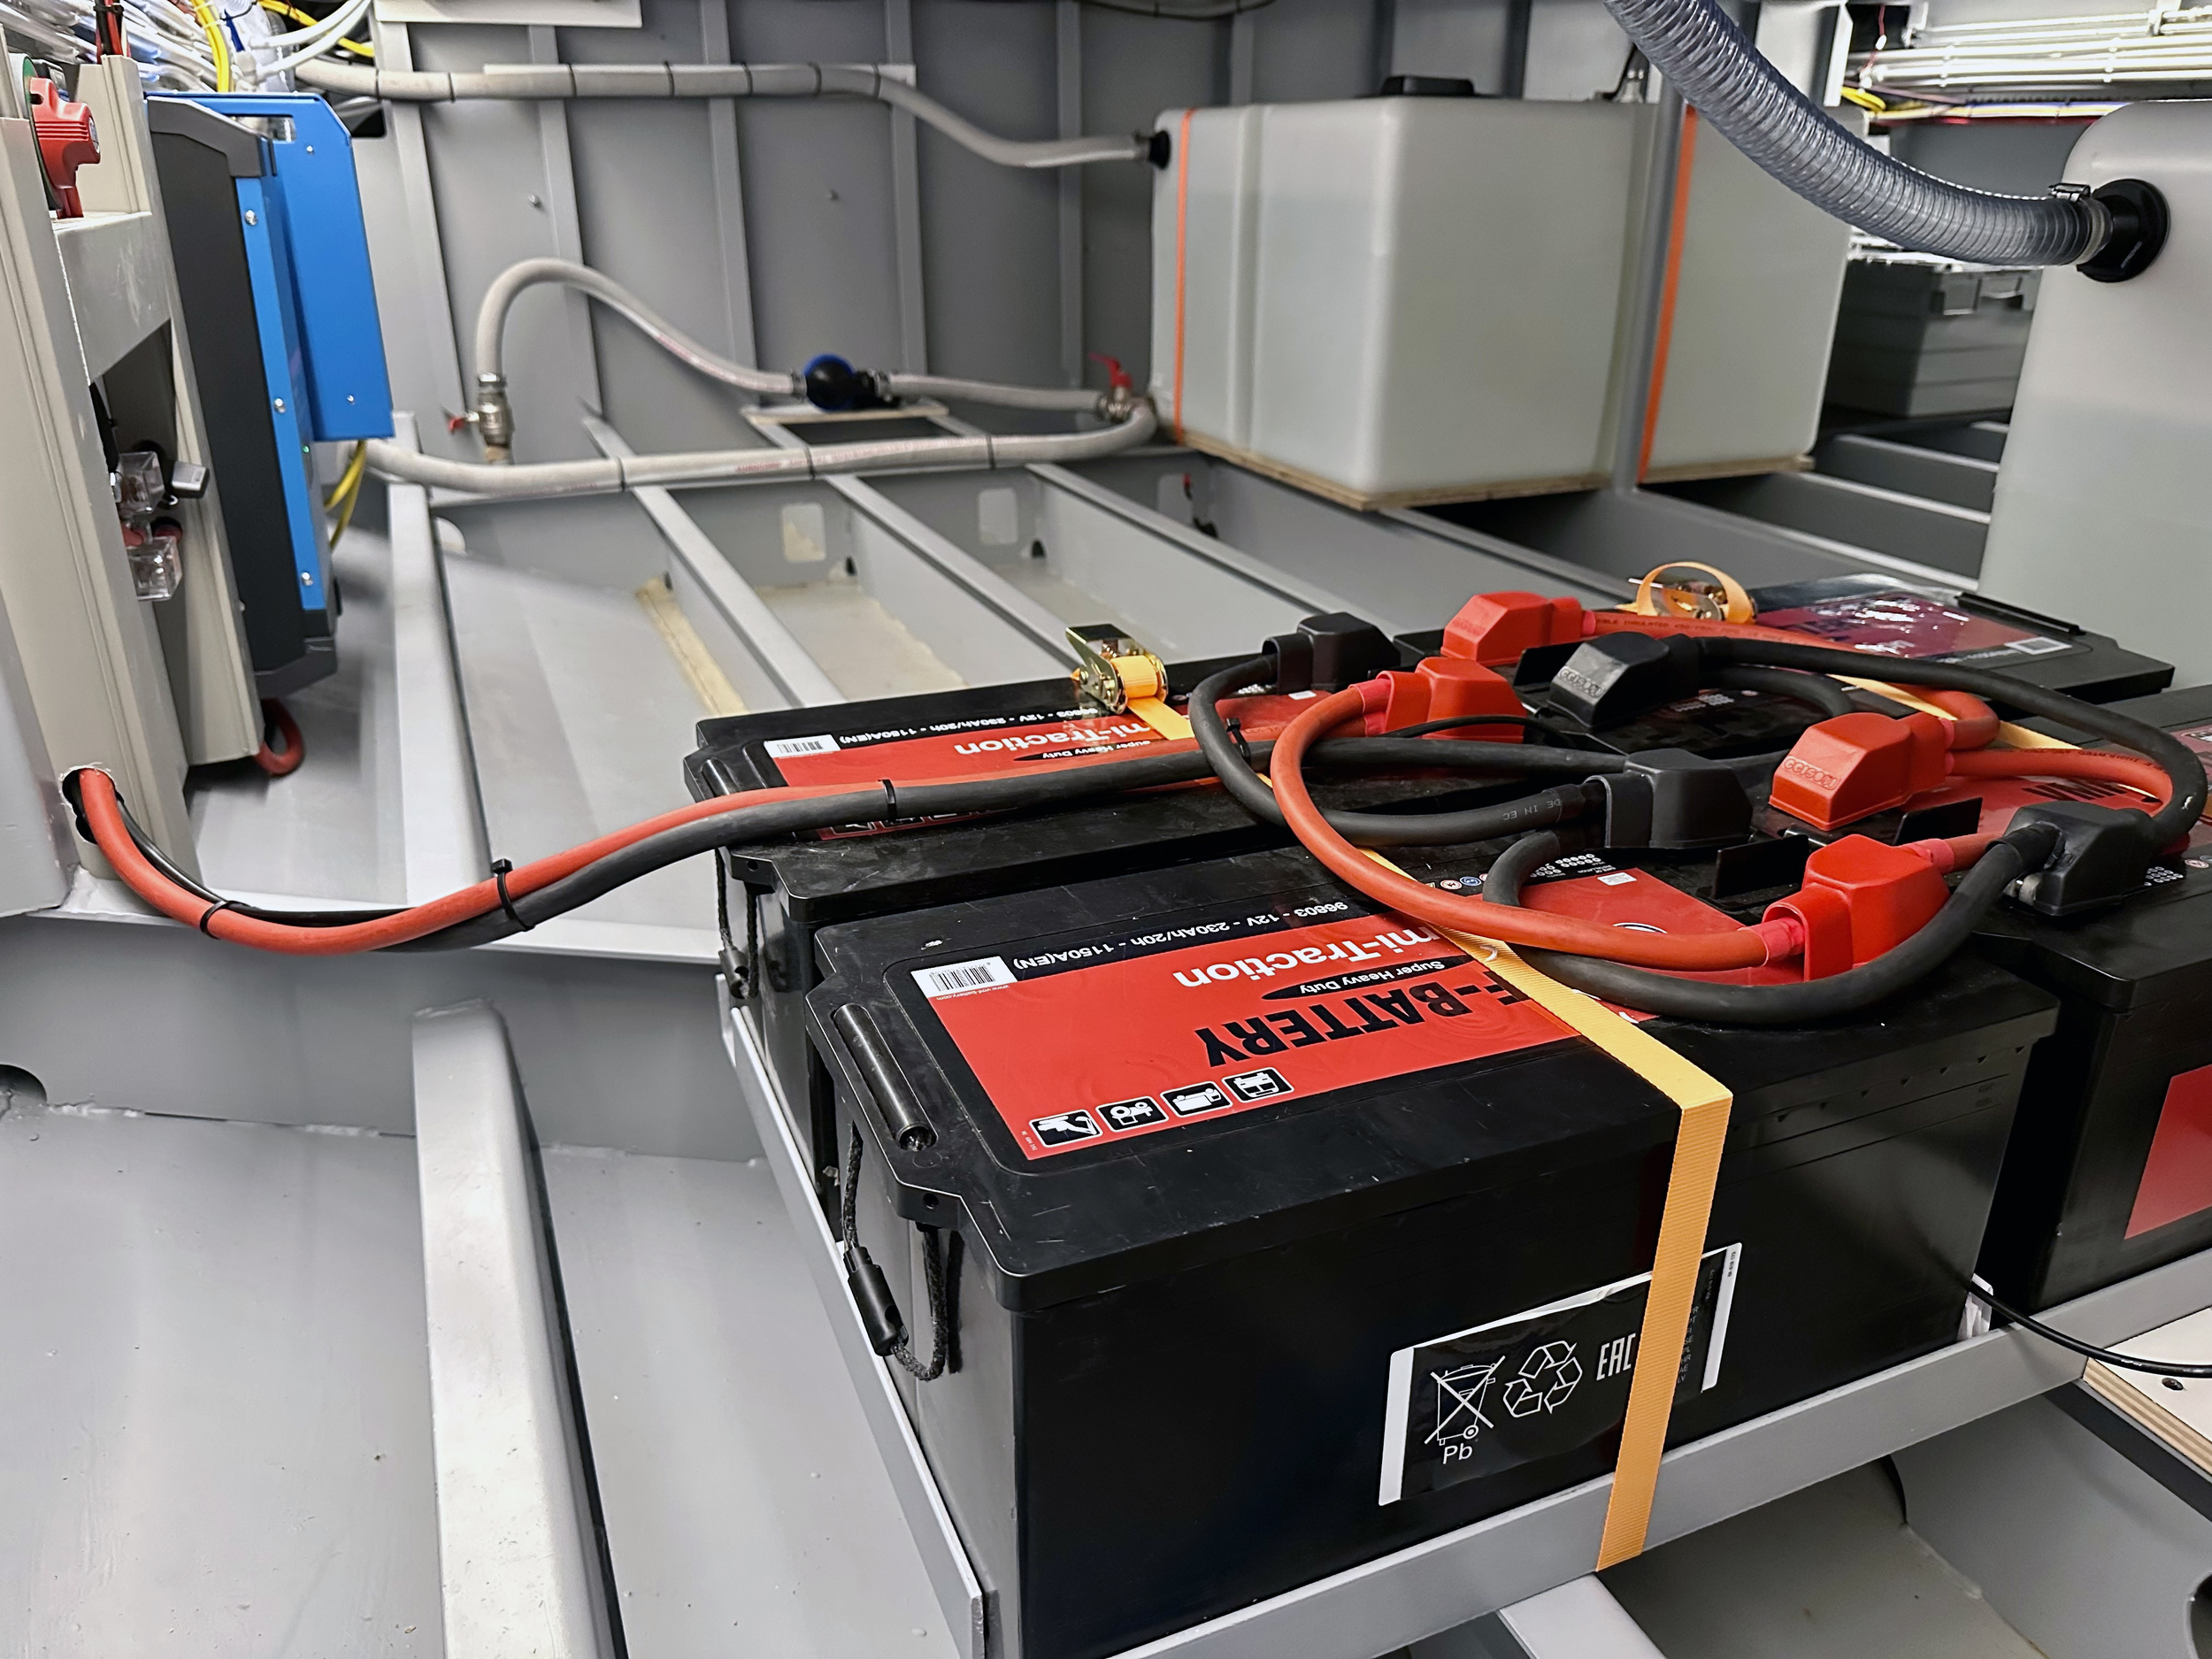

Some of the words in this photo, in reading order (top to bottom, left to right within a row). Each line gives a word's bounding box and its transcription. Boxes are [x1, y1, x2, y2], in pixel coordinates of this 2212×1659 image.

[1019, 713, 1045, 722] 12V
[840, 728, 917, 745] 1150A(EN)
[954, 723, 1151, 756] mi-Traction
[1525, 804, 1538, 815] IN
[1546, 798, 1561, 809] DE
[1502, 810, 1517, 821] EC
[1294, 901, 1348, 918] 96803
[1246, 913, 1280, 927] 12V
[1130, 921, 1230, 948] 230Ah/20h
[1013, 943, 1115, 970] 1150A(EN)
[1172, 926, 1440, 987] mi-Traction
[1395, 961, 1446, 976] Super
[1300, 979, 1342, 995] Duty
[1341, 970, 1395, 987] Heavy
[936, 984, 1010, 1001] www.vmf-battery.com
[1194, 970, 1531, 1067] F-BATTERY
[1596, 1333, 1636, 1381] EAC
[1443, 1443, 1473, 1465] Pb
